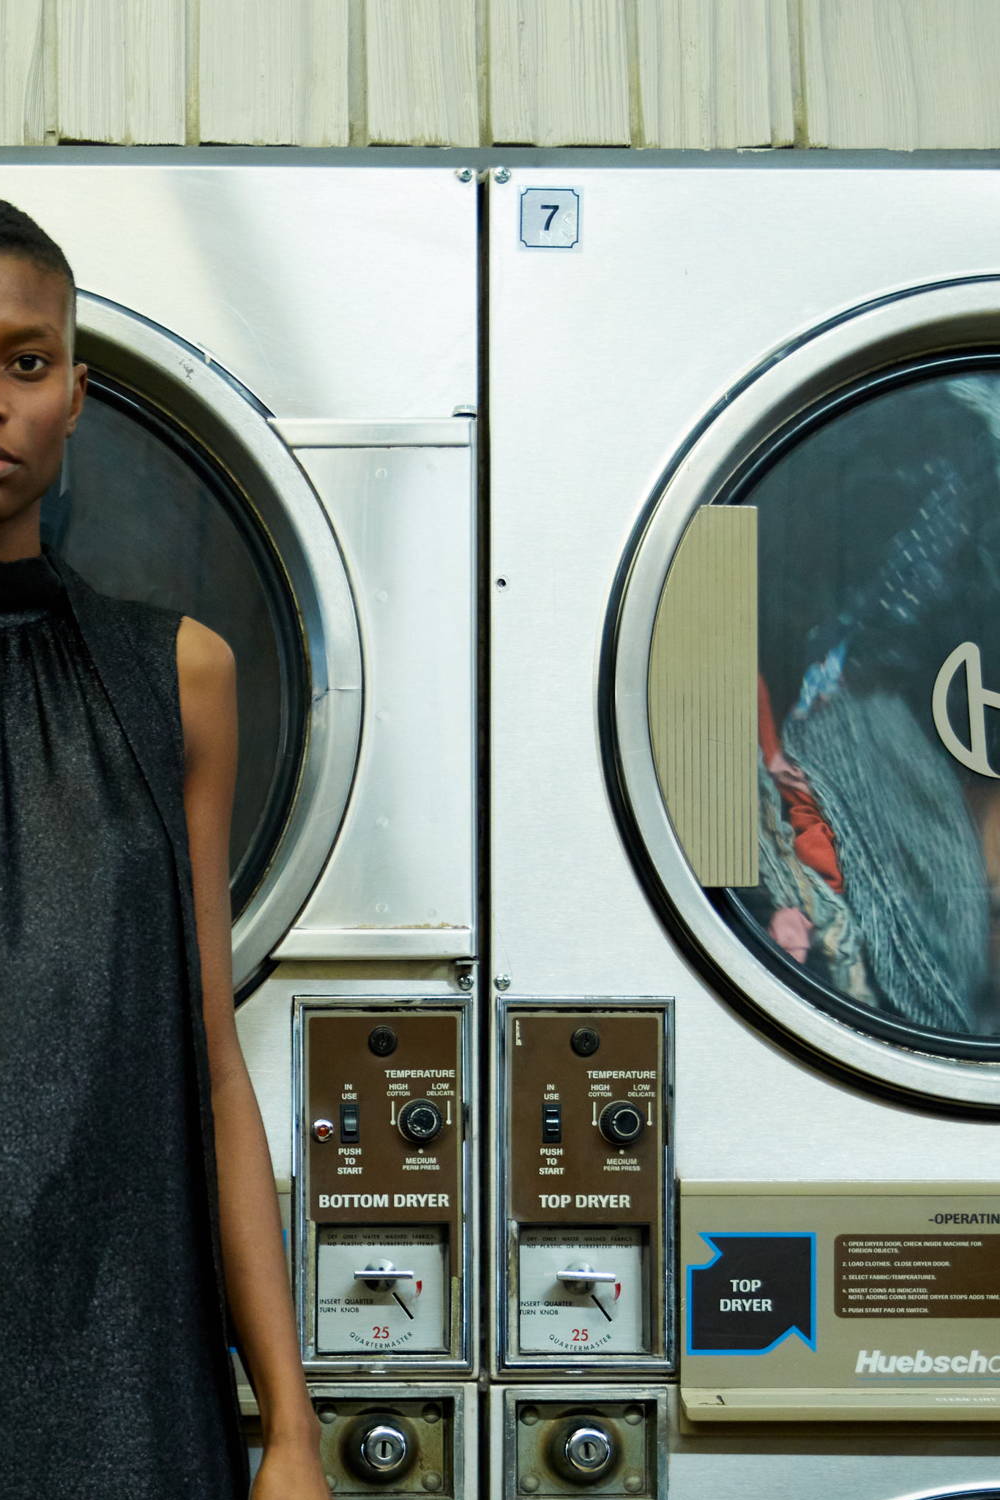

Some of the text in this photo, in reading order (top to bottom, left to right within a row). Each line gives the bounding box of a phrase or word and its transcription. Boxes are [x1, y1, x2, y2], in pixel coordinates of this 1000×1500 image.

[540, 205, 560, 231] 7
[384, 1069, 456, 1078] TEMPERATURE
[586, 1070, 657, 1079] TEMPERATURE
[540, 1148, 563, 1156] PUSH
[344, 1157, 355, 1165] TO
[337, 1167, 363, 1175] START
[538, 1167, 565, 1175] START
[318, 1193, 450, 1209] BOTTOM DRYER
[538, 1194, 631, 1209] TOP DRYER
[730, 1279, 762, 1293] TOP
[719, 1298, 773, 1312] DRYER
[372, 1326, 390, 1339] 25
[571, 1328, 589, 1342] 25
[349, 1331, 413, 1349] QUARTERMASTER
[548, 1334, 612, 1352] QUARTERMASTER
